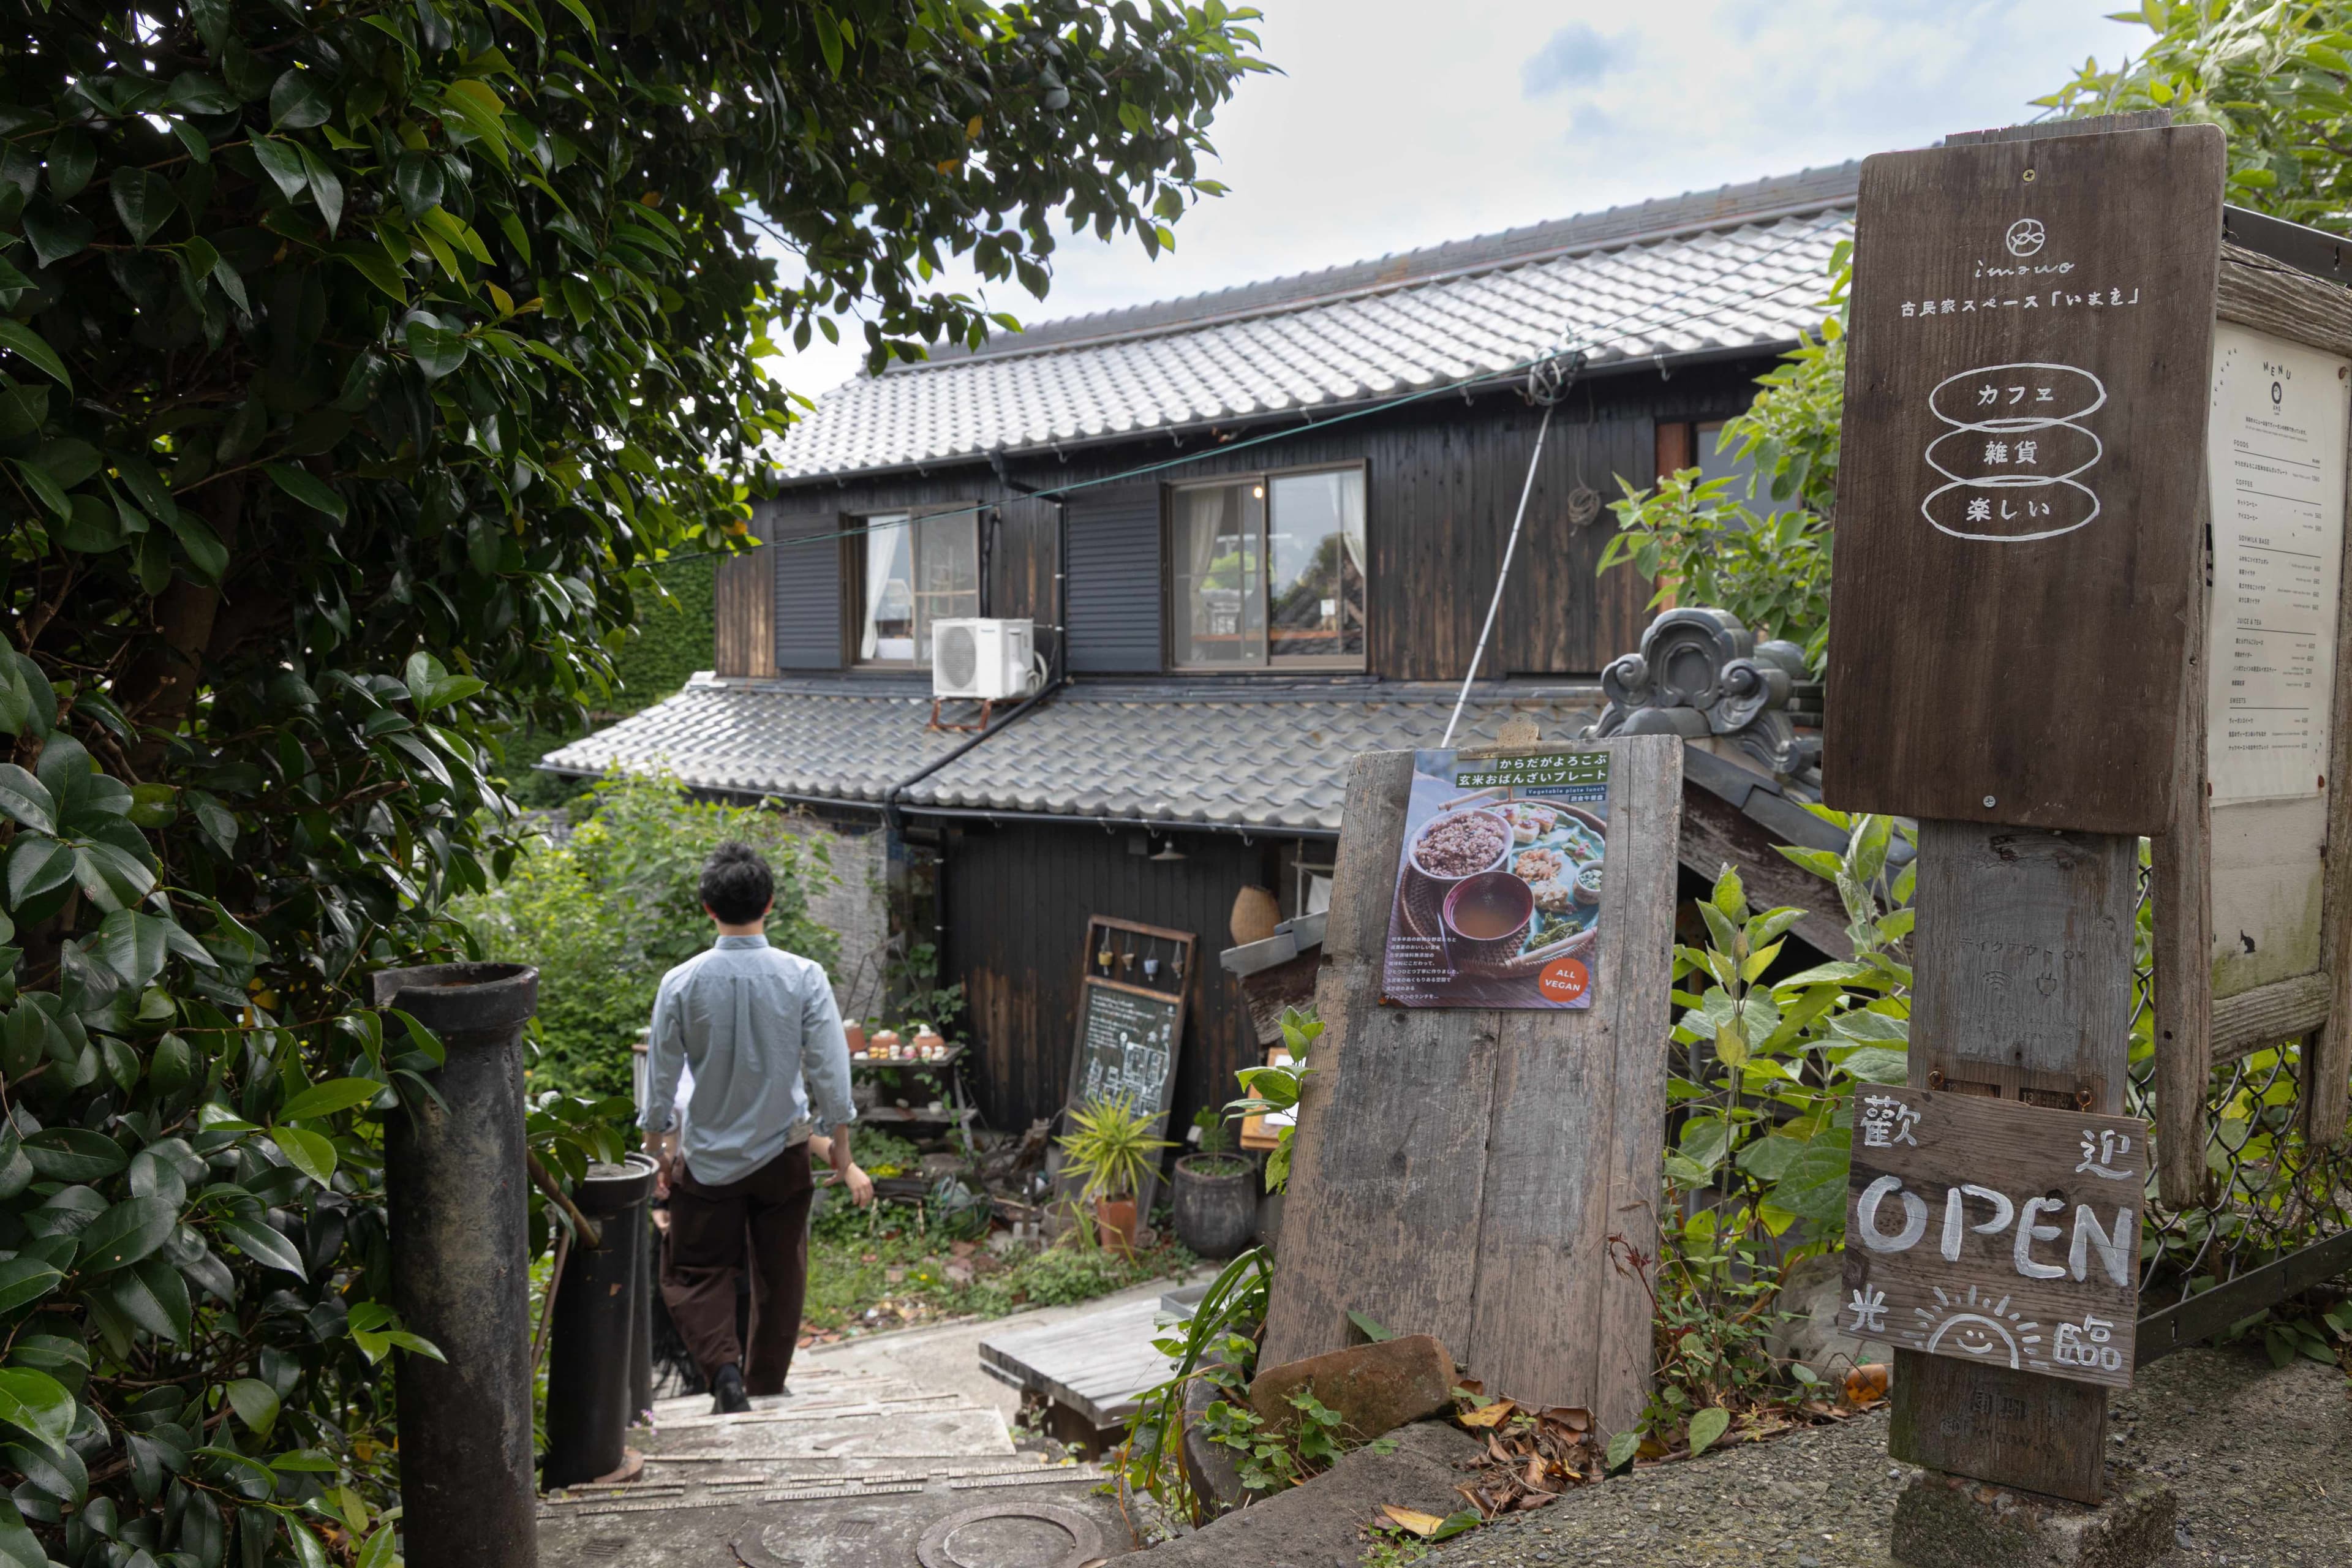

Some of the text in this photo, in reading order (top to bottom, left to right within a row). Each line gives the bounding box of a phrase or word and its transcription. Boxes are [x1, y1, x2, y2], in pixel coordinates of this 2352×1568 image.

[2263, 361, 2291, 380] MENU
[2234, 440, 2249, 448] FOODS
[1983, 440, 2038, 465] 雑貨
[2236, 478, 2253, 488] COFFEE
[1966, 497, 2050, 522] 楽しい
[2239, 535, 2258, 543] SOYMILK
[1499, 755, 1607, 769] からだがよろこぶ
[1458, 769, 1607, 786] 玄米おばんざいプレート
[1556, 970, 1575, 978] ALL
[1545, 979, 1580, 992] VEGAN
[1857, 1174, 2133, 1286] OPEN
